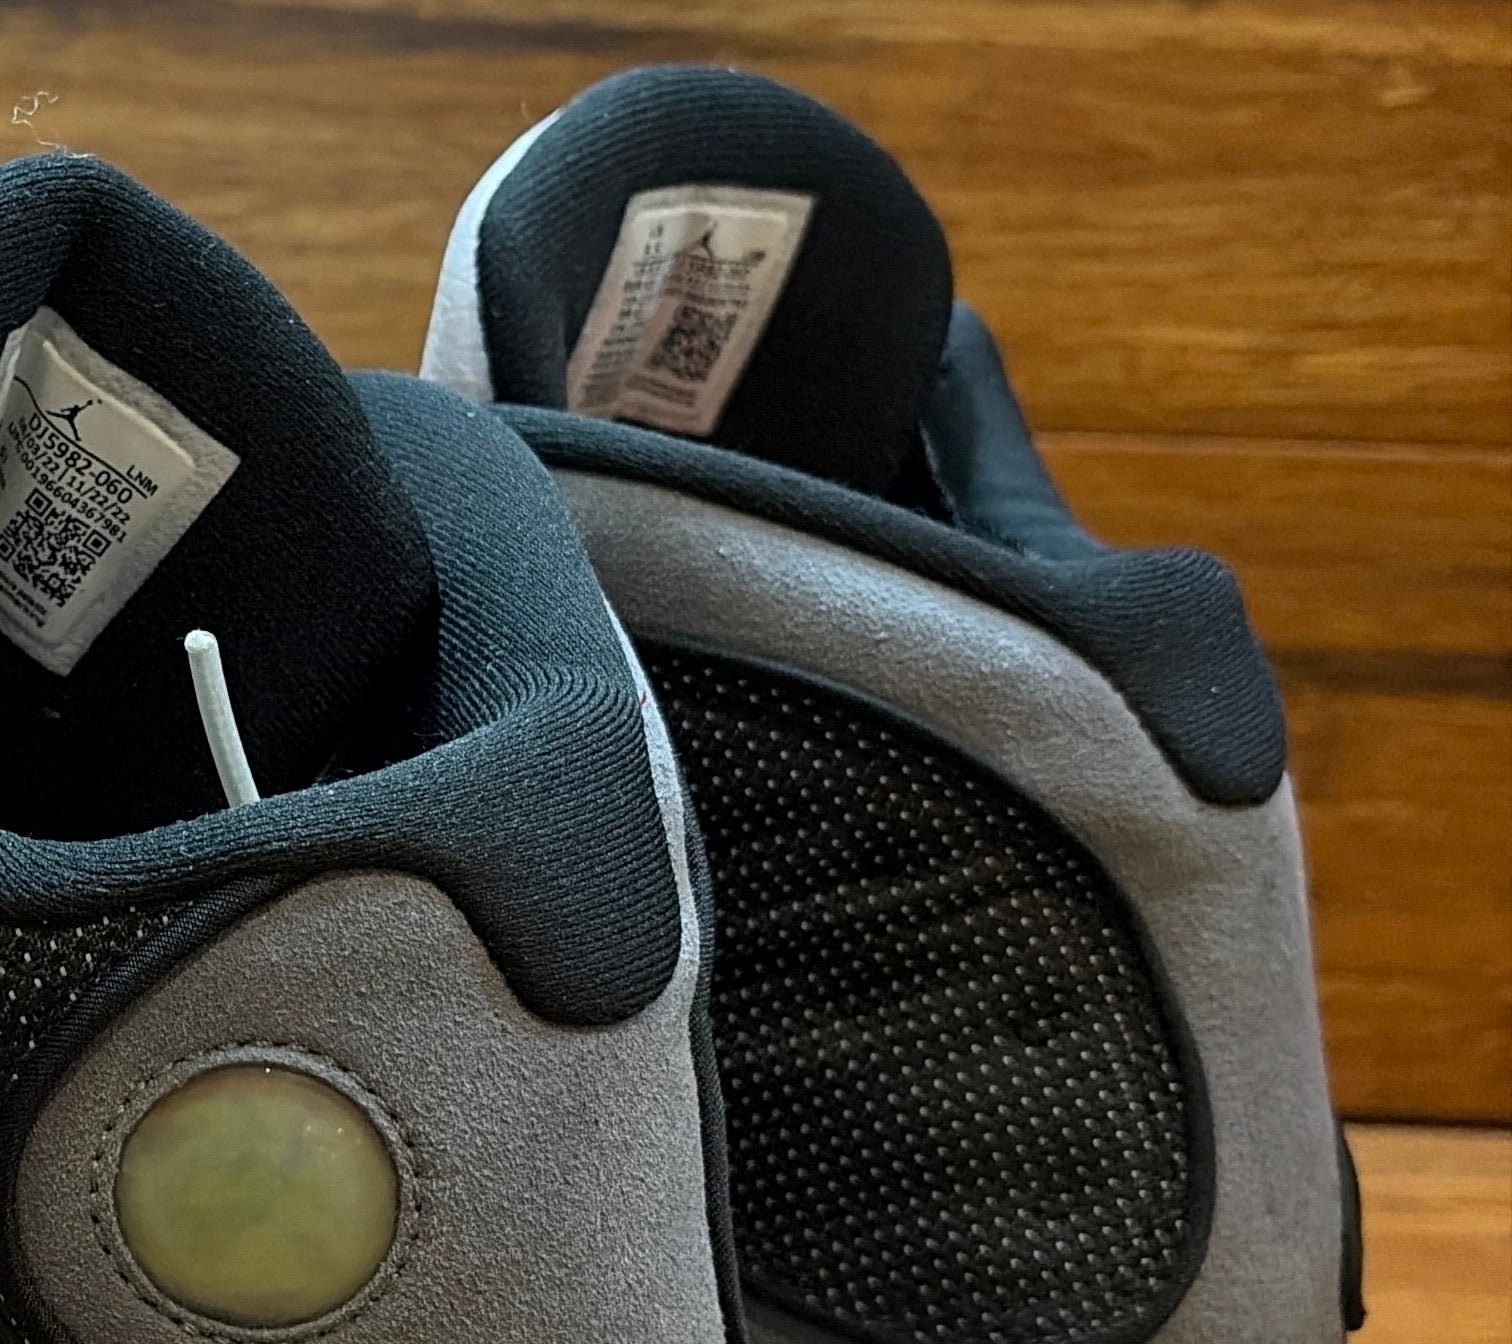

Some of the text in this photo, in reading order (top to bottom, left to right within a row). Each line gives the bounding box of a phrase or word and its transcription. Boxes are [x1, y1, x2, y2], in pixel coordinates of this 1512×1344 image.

[29, 412, 134, 505] DJ5982-060
[126, 464, 159, 497] LNM
[66, 475, 131, 526] 11/22/22
